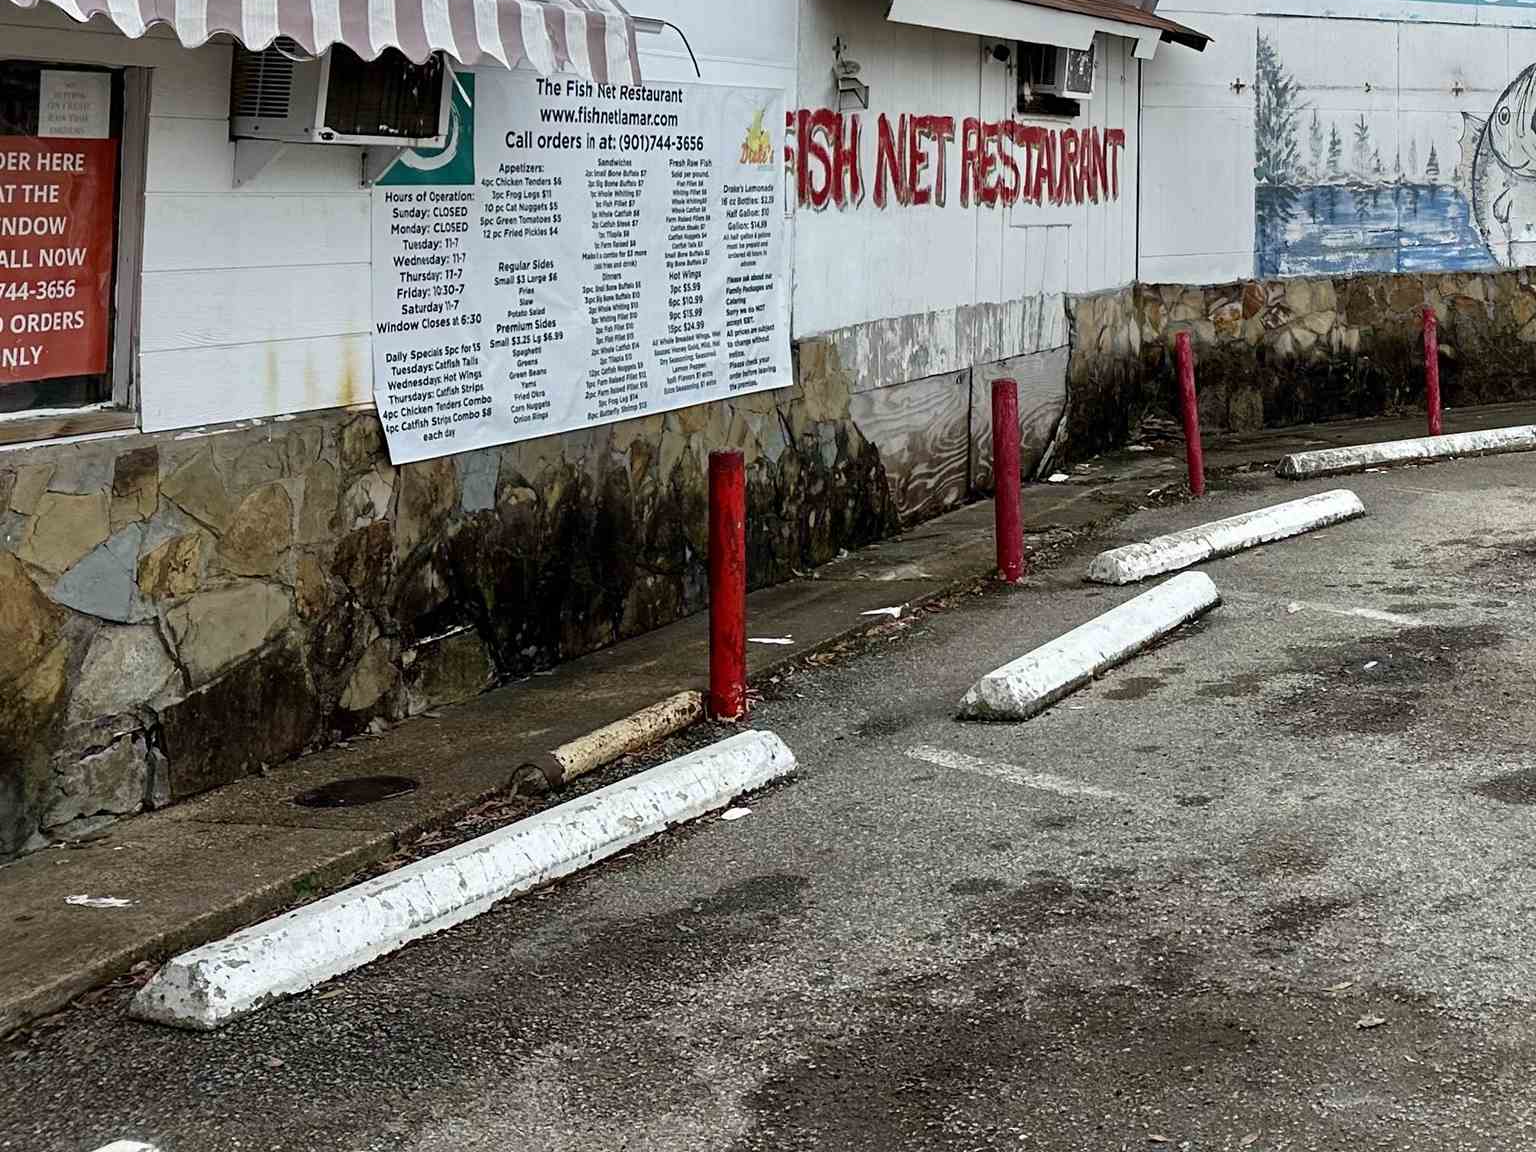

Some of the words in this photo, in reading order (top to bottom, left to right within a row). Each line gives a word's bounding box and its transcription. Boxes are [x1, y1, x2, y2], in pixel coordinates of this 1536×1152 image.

[536, 78, 561, 96] The
[567, 80, 593, 98] Fish
[598, 83, 616, 99] Net
[620, 85, 683, 103] Restaurant
[540, 106, 679, 127] www.fishnetlamar.com
[505, 131, 533, 149] Call
[537, 132, 582, 149] orders
[586, 132, 596, 149] in
[599, 134, 616, 150] at:
[619, 134, 704, 152] (901)744-3656
[37, 153, 85, 171] HERE
[499, 162, 544, 174] Appetizers:
[669, 158, 686, 167] Fresh
[699, 158, 713, 167] Fish
[873, 113, 956, 209] NET
[960, 117, 1125, 209] RESTAURANT
[495, 177, 522, 186] Chicken
[525, 177, 551, 186] Tenders
[21, 185, 60, 203] THE
[385, 192, 413, 203] Hours
[416, 191, 427, 202] of
[429, 191, 475, 204] Operation:
[505, 190, 522, 200] Frog
[523, 190, 540, 200] Legs
[392, 207, 431, 220] Sunday:
[433, 207, 468, 218] CLOSED
[496, 216, 518, 225] Green
[0, 216, 67, 235] NDOW
[391, 223, 431, 235] Monday:
[433, 222, 469, 233] CLOSED
[483, 230, 491, 239] 12
[492, 230, 502, 240] pc
[503, 228, 523, 238] Fried
[402, 239, 443, 251] Tuesday:
[445, 237, 459, 248] 11-7
[39, 248, 87, 267] NOW
[393, 253, 450, 267] Wednesday:
[452, 252, 466, 264] 11-7
[498, 260, 531, 273] Regular
[532, 259, 554, 270] Sides
[399, 270, 443, 282] Thursday:
[445, 268, 463, 279] 11-7
[494, 275, 515, 286] Small
[527, 274, 547, 284] Large
[669, 271, 681, 280] Hot
[682, 270, 701, 280] Wings
[396, 287, 431, 299] Friday:
[401, 302, 444, 315] Saturday
[10, 311, 84, 333] ORDERS
[376, 319, 419, 334] Window
[422, 318, 451, 330] Closes
[461, 313, 482, 325] 6:30
[496, 322, 533, 334] Premium
[534, 318, 557, 330] Sides
[489, 337, 510, 348] Small
[385, 352, 408, 363] Daily
[410, 348, 443, 360] Specials
[444, 345, 459, 356] 5pc
[461, 344, 471, 353] for
[391, 364, 434, 376] Tuesdays:
[434, 358, 460, 370] Catfish
[462, 356, 479, 366] Tails
[443, 373, 457, 383] Hot
[458, 370, 482, 380] Wings
[388, 391, 434, 405] Thursdays:
[436, 386, 460, 398] Catfish
[461, 383, 484, 393] Strips
[382, 409, 399, 421] 4pc
[400, 405, 433, 417] Chicken
[435, 400, 461, 412] Tenders
[463, 395, 492, 407] Combo
[401, 417, 429, 431] Catfish
[431, 415, 452, 426] Strips
[453, 410, 480, 422] Combo
[423, 430, 443, 442] each
